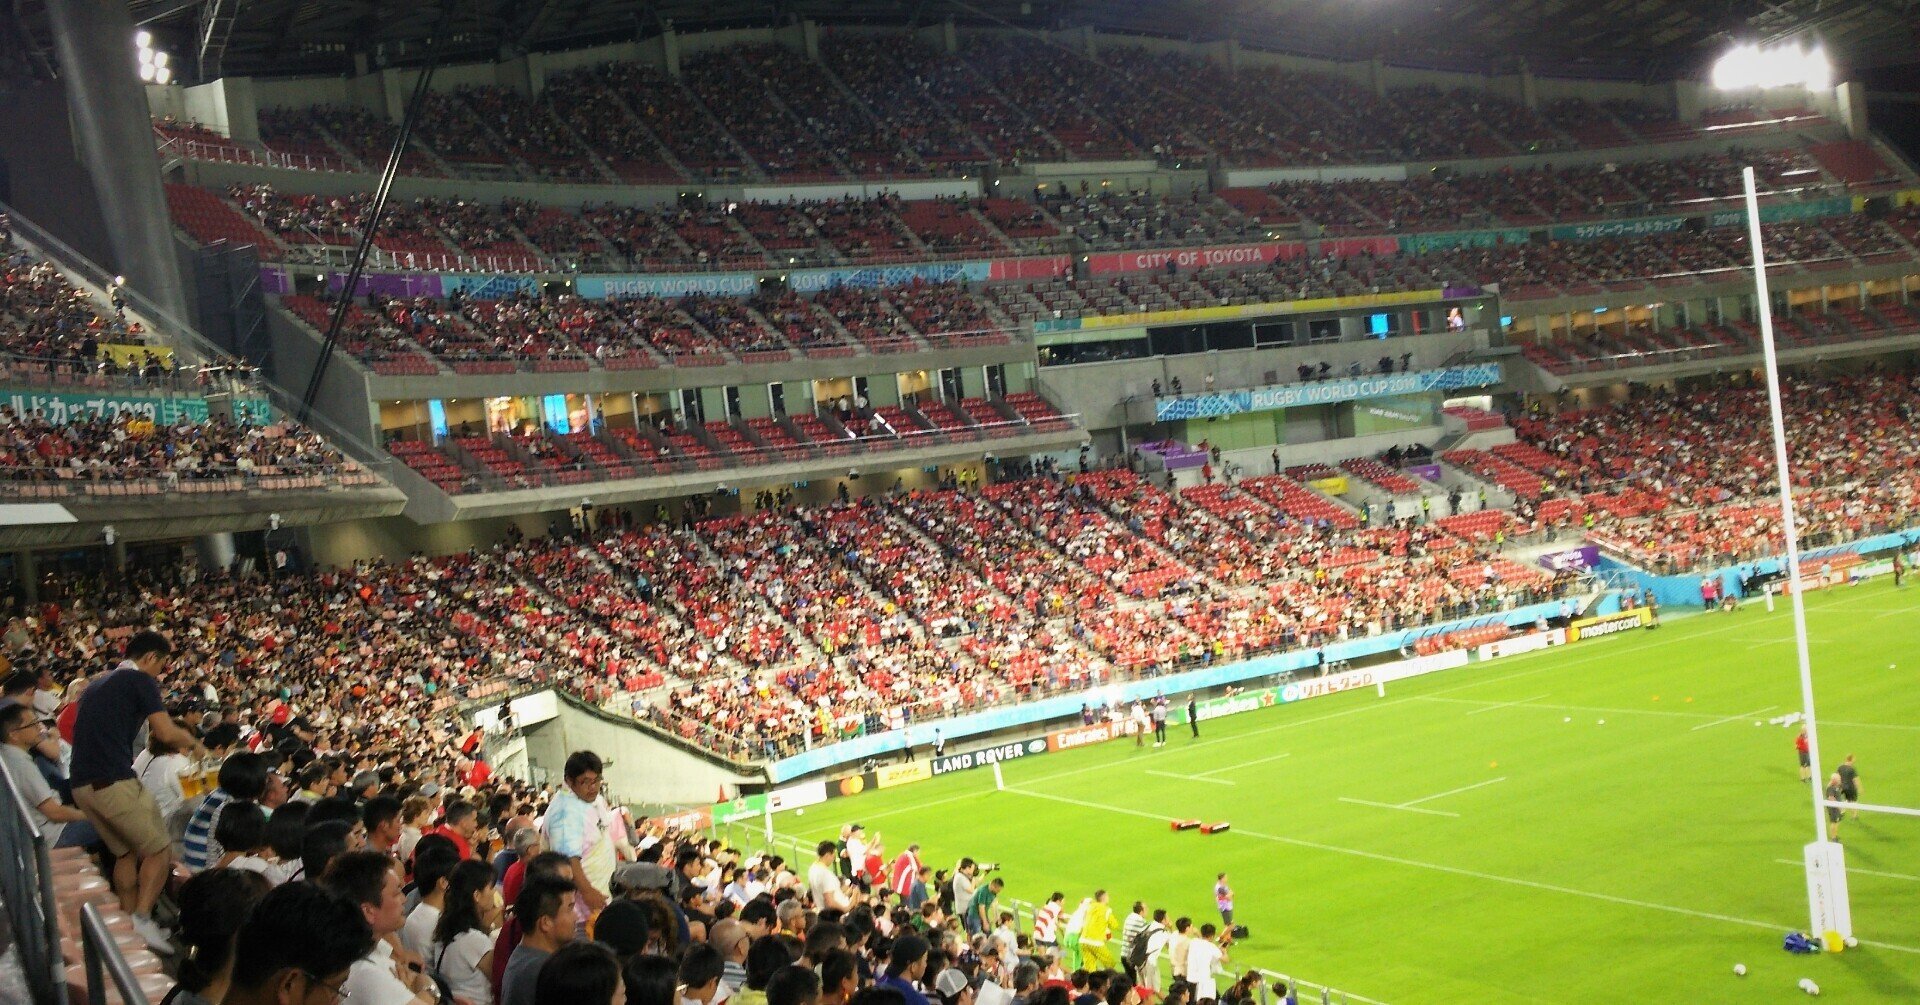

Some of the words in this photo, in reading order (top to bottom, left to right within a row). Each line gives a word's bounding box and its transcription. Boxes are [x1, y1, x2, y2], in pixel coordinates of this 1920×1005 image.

[1136, 253, 1172, 269] CITY
[1177, 251, 1198, 266] OF
[1203, 248, 1263, 265] TOYOTA
[603, 280, 655, 295] RUGBY
[660, 279, 717, 294] WORLD
[719, 277, 755, 293] CUP
[792, 273, 828, 292] 2019
[1253, 389, 1303, 408] RUGBY
[1307, 384, 1358, 402] WORLD
[1359, 380, 1388, 396] CUP
[1580, 614, 1642, 639] mastercard
[932, 754, 972, 775] LAND
[976, 743, 1025, 767] ROVER
